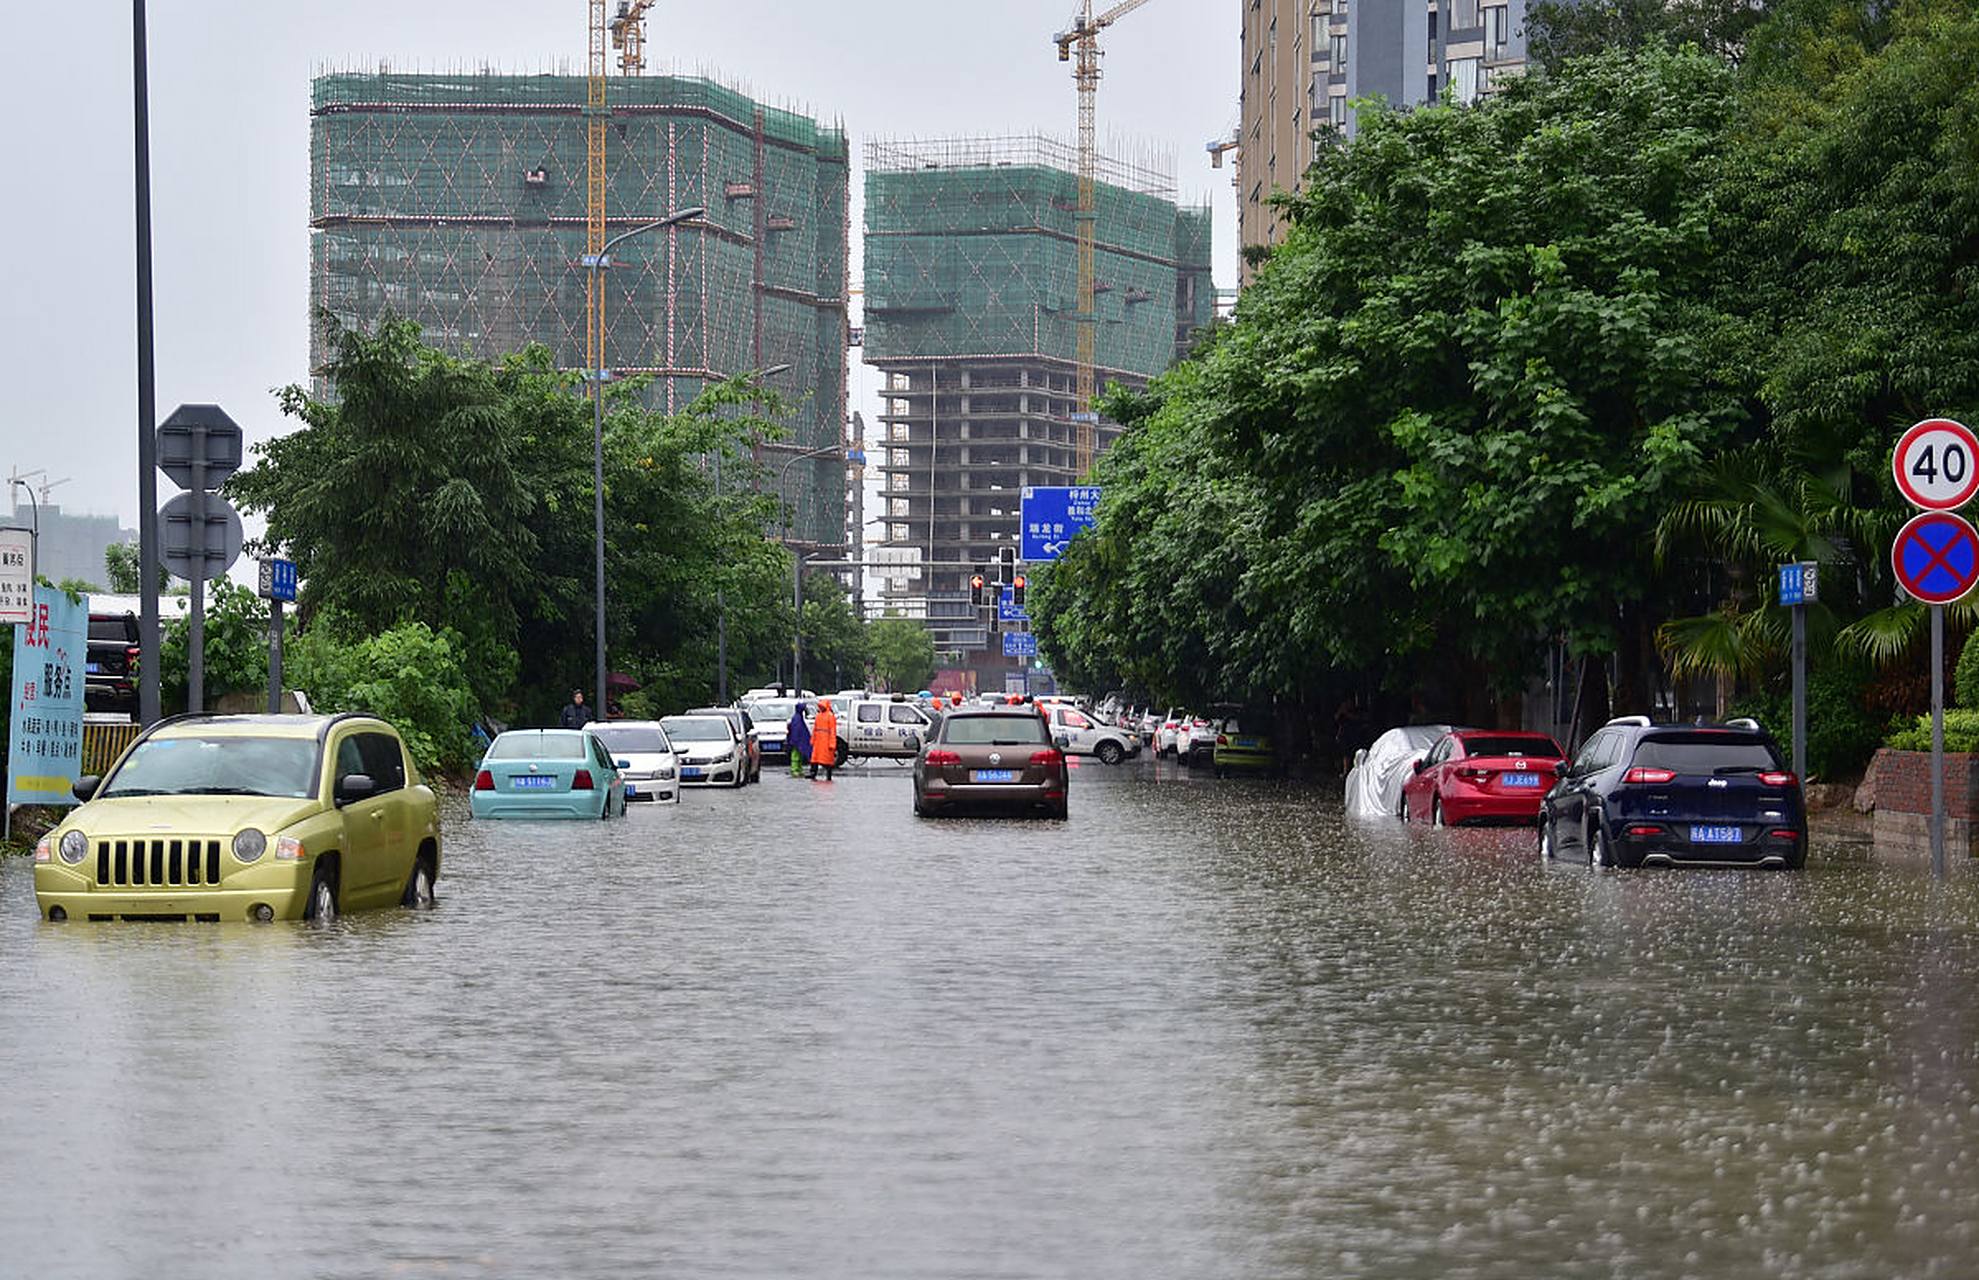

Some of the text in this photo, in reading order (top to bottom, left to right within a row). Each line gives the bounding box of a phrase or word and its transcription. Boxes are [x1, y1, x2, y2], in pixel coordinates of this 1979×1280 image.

[1912, 443, 1966, 485] 40
[43, 662, 72, 699] 服务点
